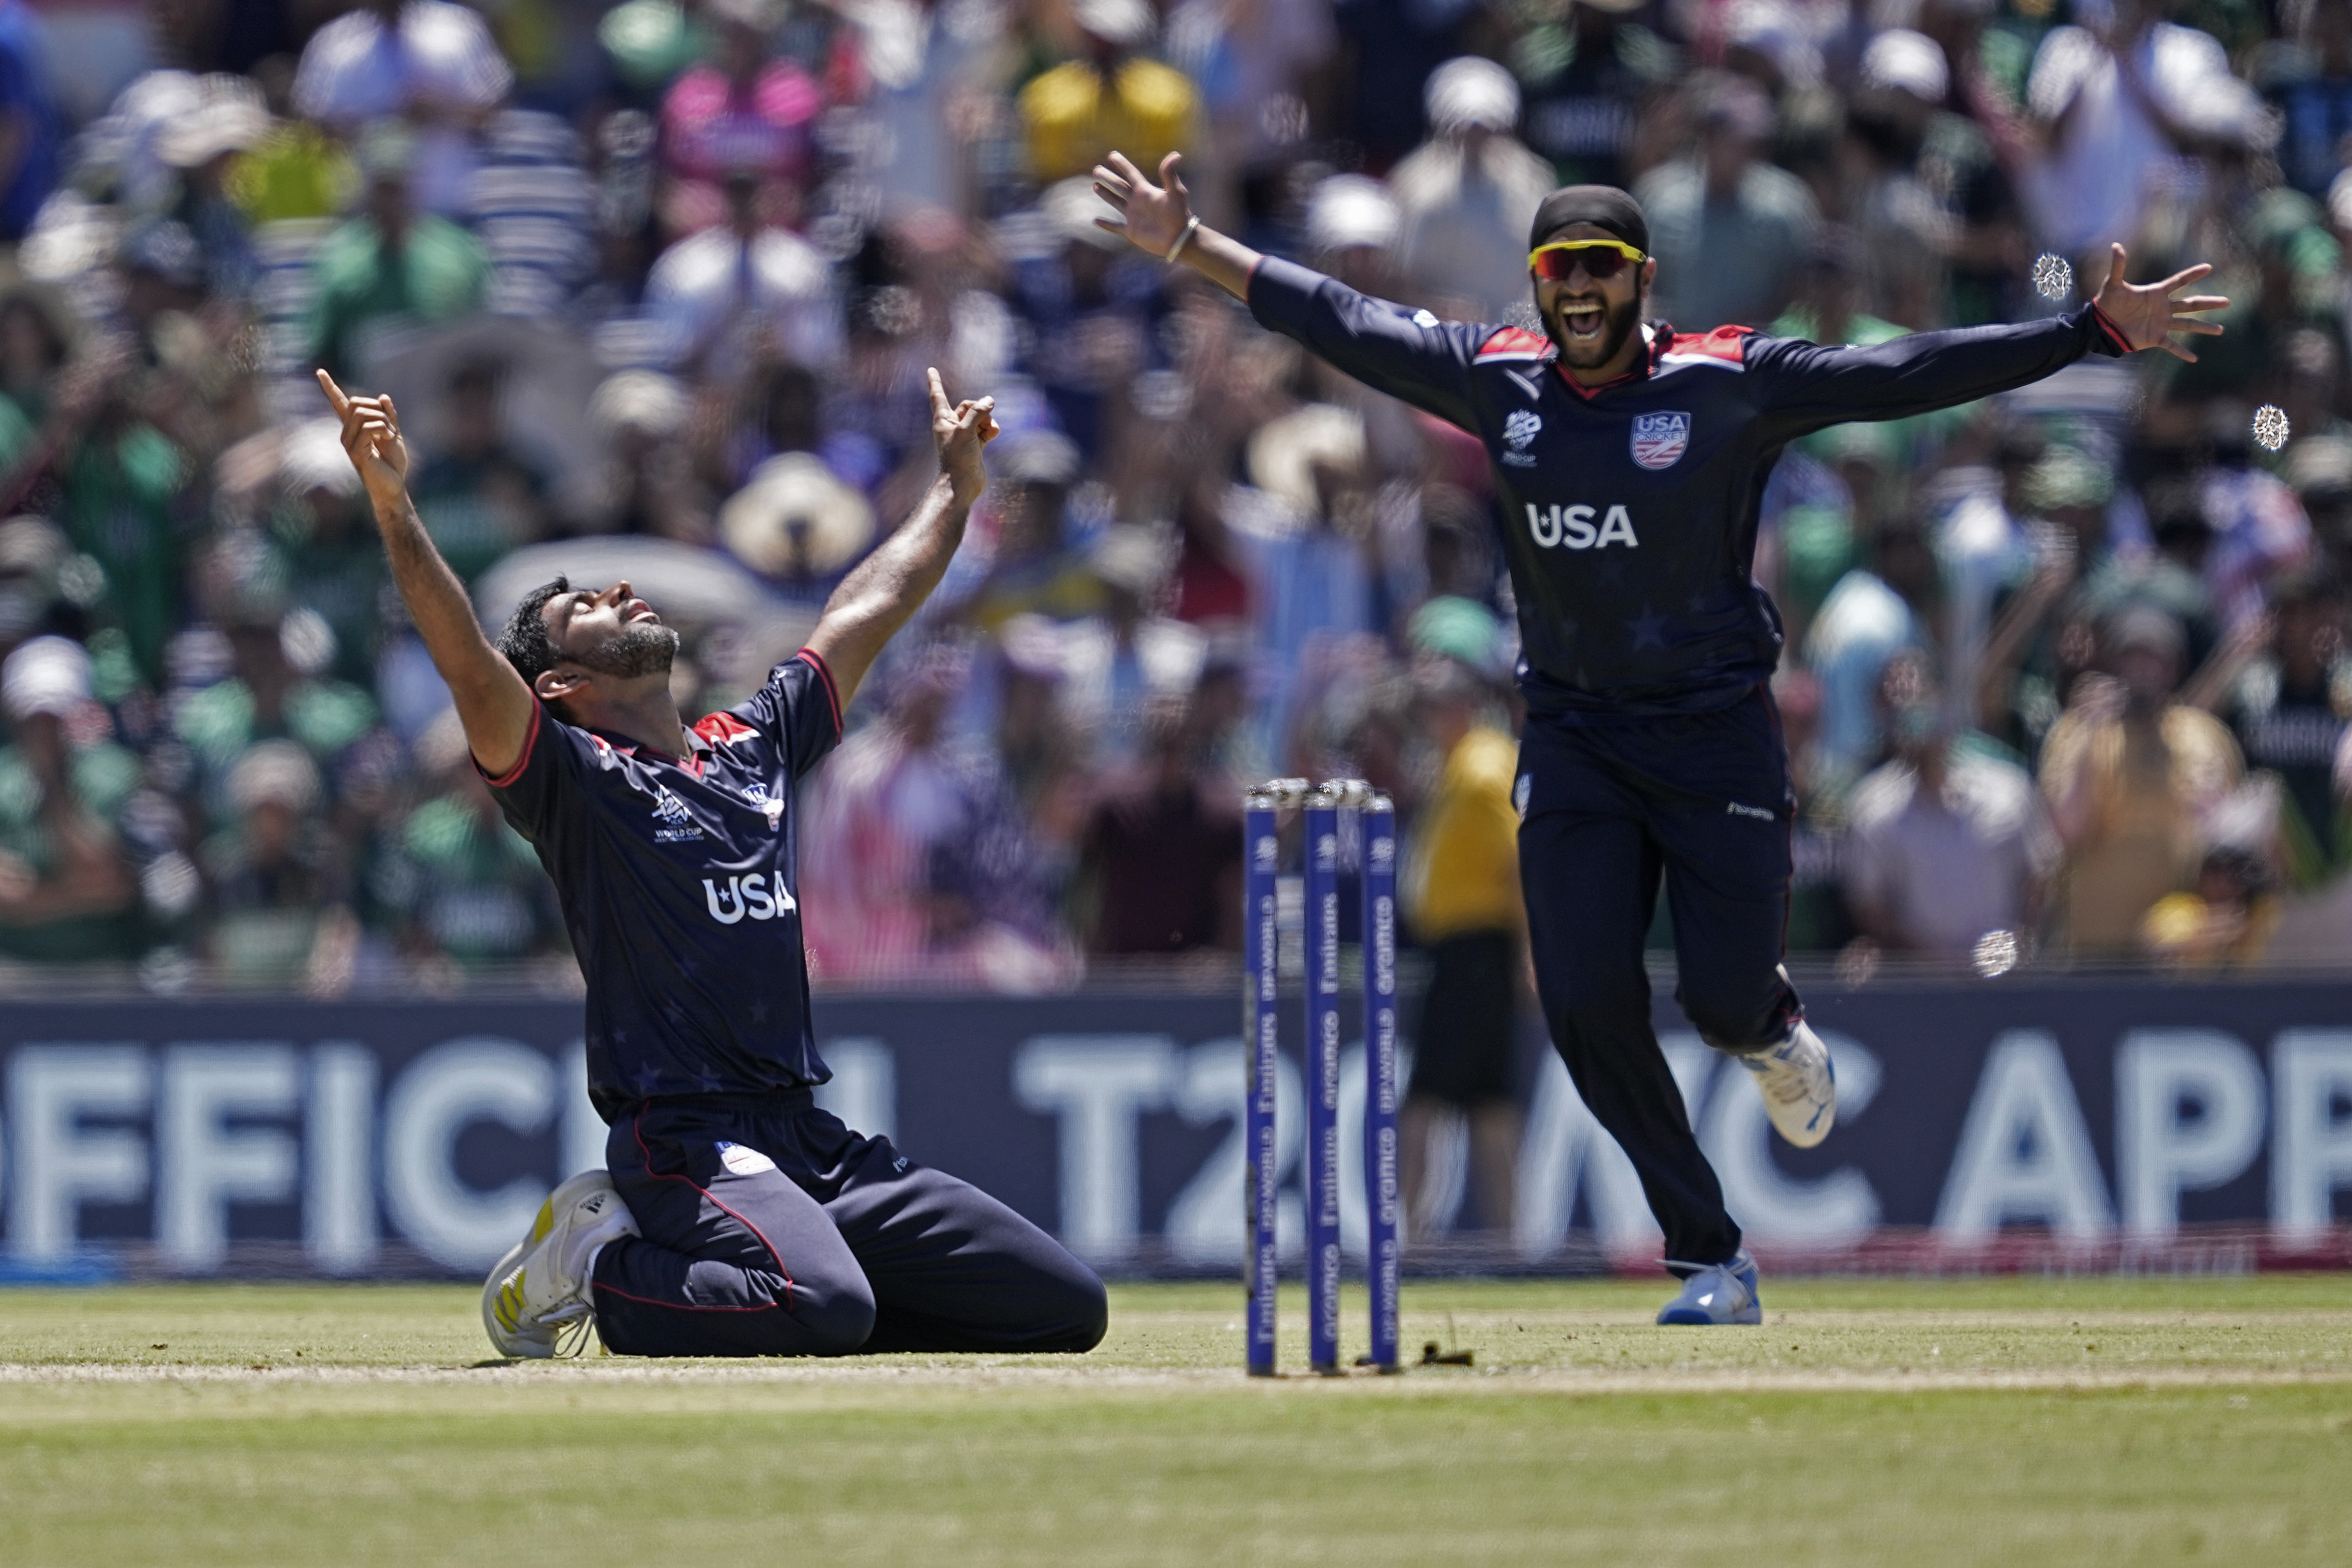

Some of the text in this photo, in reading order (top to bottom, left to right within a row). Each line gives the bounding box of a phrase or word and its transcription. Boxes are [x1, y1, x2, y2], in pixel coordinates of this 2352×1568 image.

[1636, 432, 1684, 441] CRICKET
[1637, 415, 1686, 432] USA
[1525, 502, 1639, 549] USA
[655, 829, 685, 838] WORLD
[685, 827, 703, 837] CUP
[701, 870, 796, 925] USA
[1930, 1026, 2352, 1254] APP
